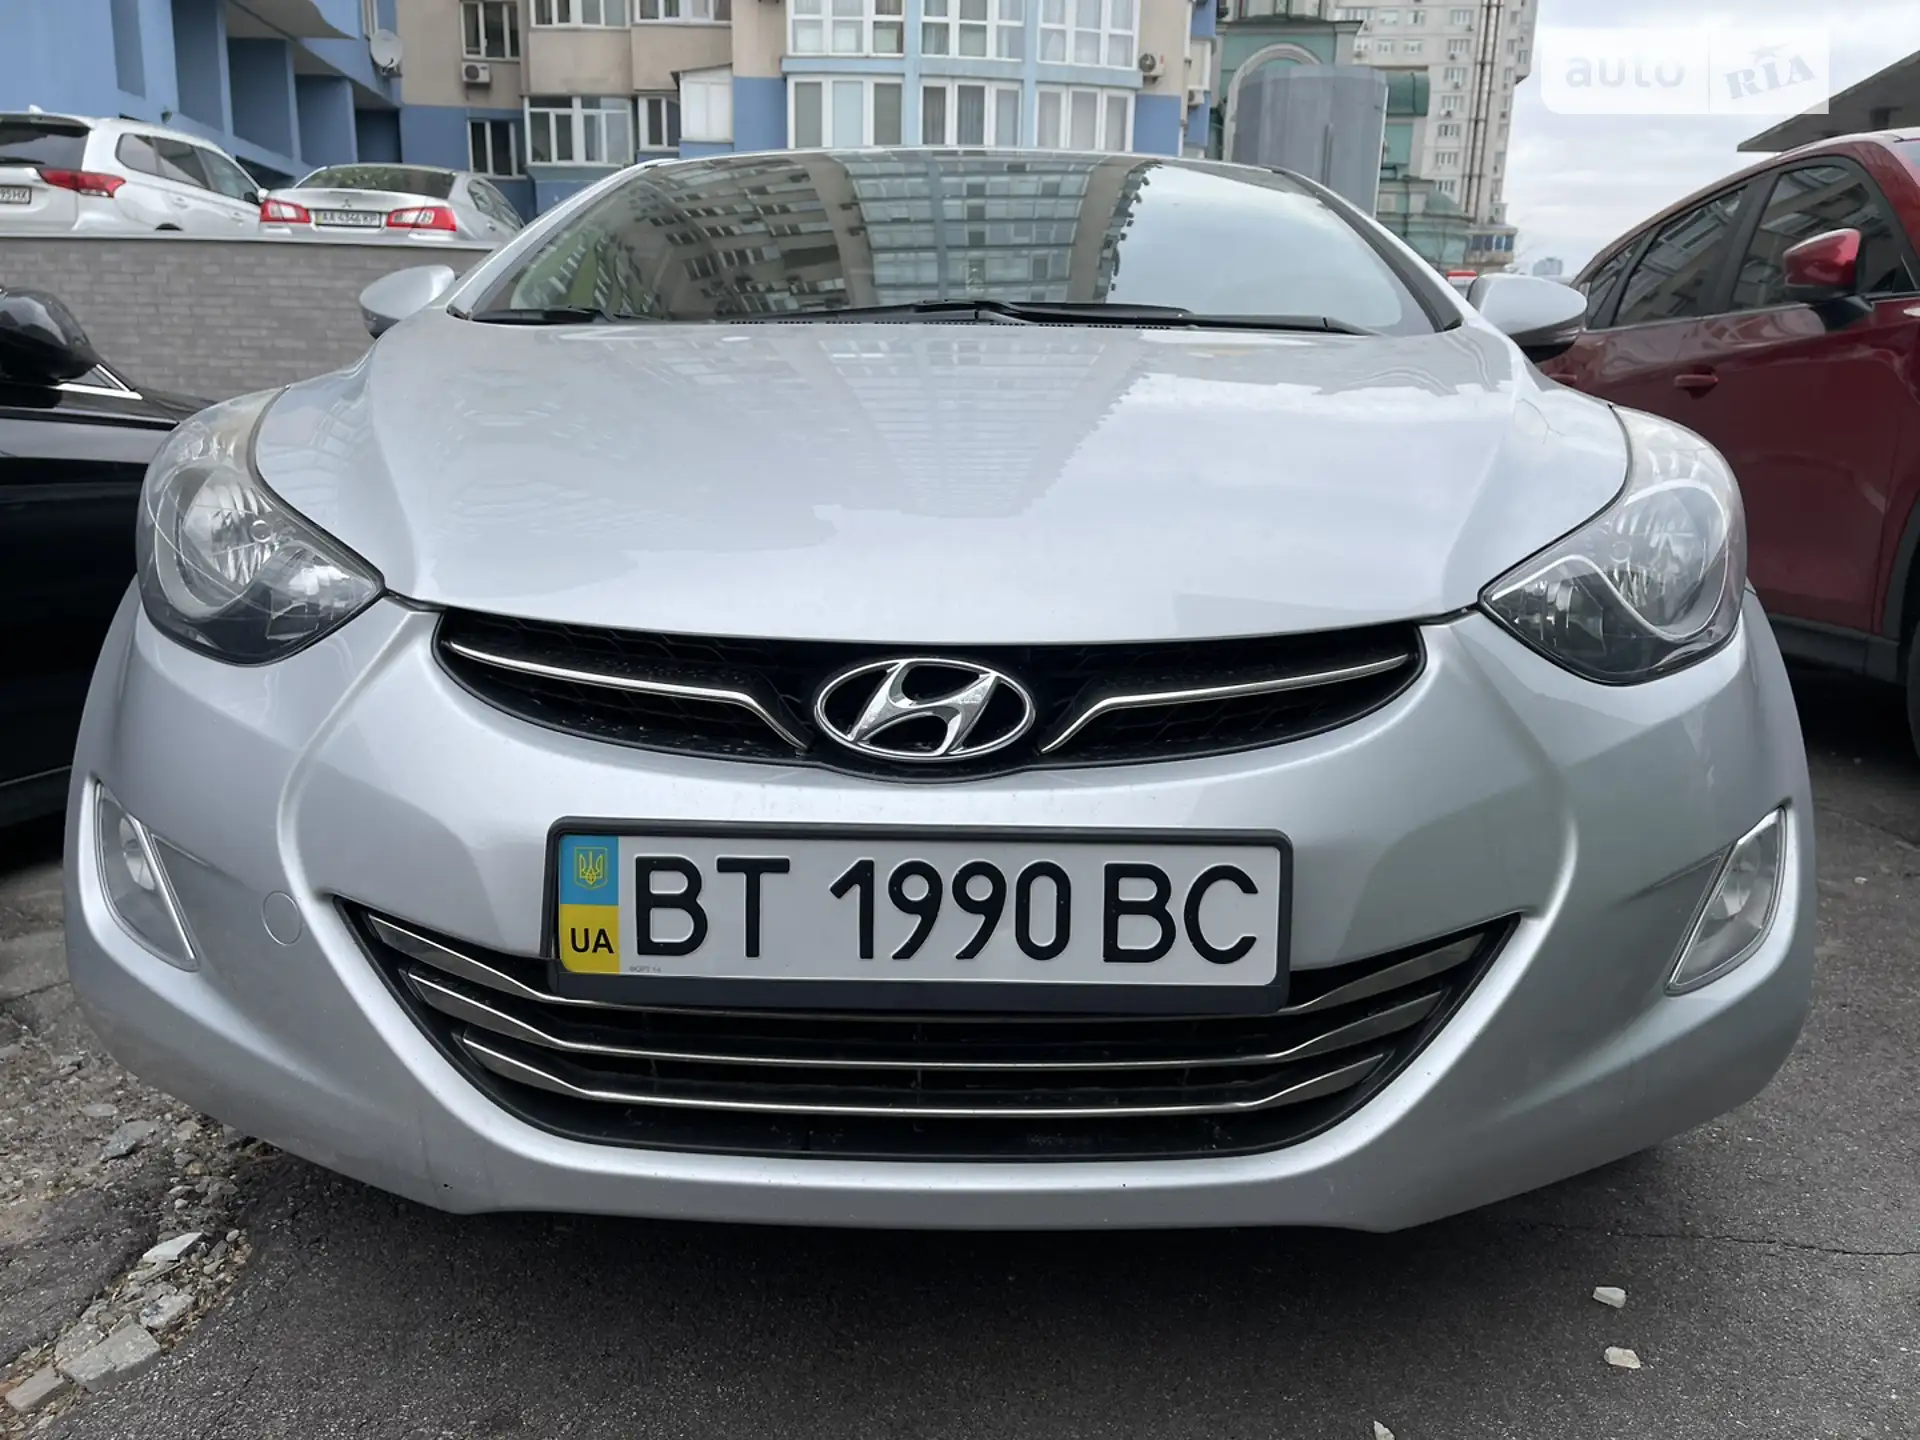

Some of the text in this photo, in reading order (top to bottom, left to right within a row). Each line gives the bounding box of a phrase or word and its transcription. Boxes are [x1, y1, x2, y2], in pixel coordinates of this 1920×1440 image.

[570, 927, 615, 954] UA
[635, 855, 1259, 965] BT 1990 BC
